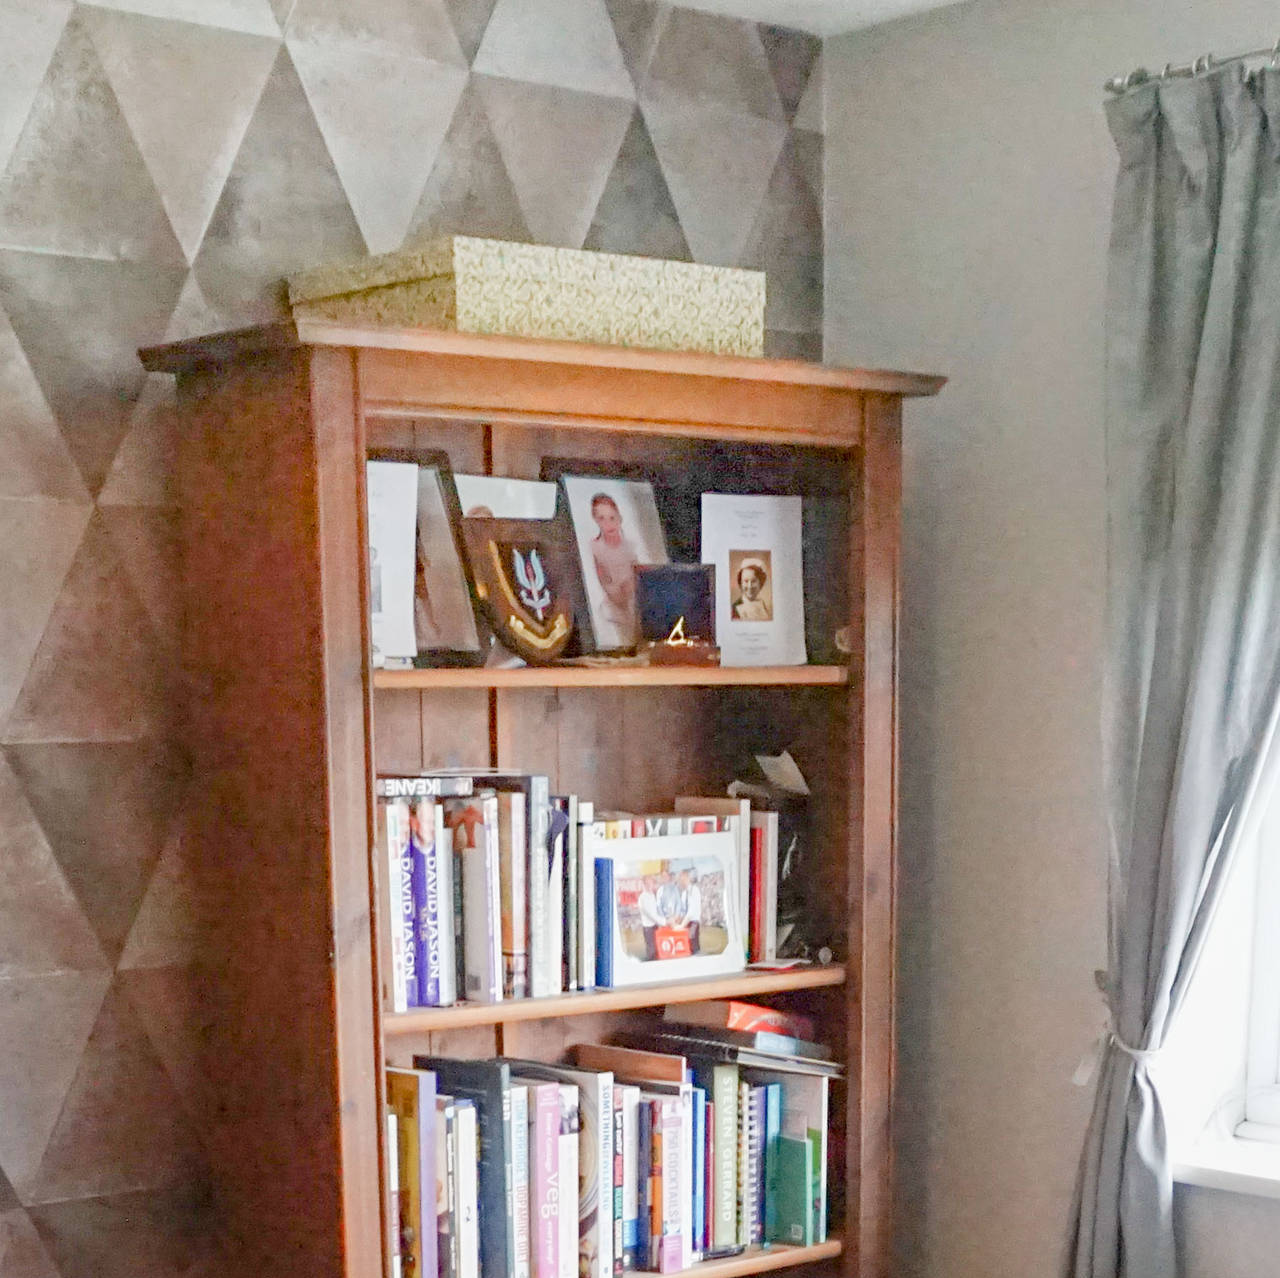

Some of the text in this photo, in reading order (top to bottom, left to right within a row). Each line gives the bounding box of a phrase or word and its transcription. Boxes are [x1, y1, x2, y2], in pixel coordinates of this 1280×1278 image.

[385, 779, 439, 796] KEANE
[401, 857, 416, 979] DAVID JASON
[427, 857, 440, 978] DAVID JASON
[602, 1085, 610, 1150] SOMETHING
[722, 1077, 733, 1222] STEVEN GERRARD
[541, 1172, 559, 1219] veg
[668, 1152, 680, 1218] COCKTAILS
